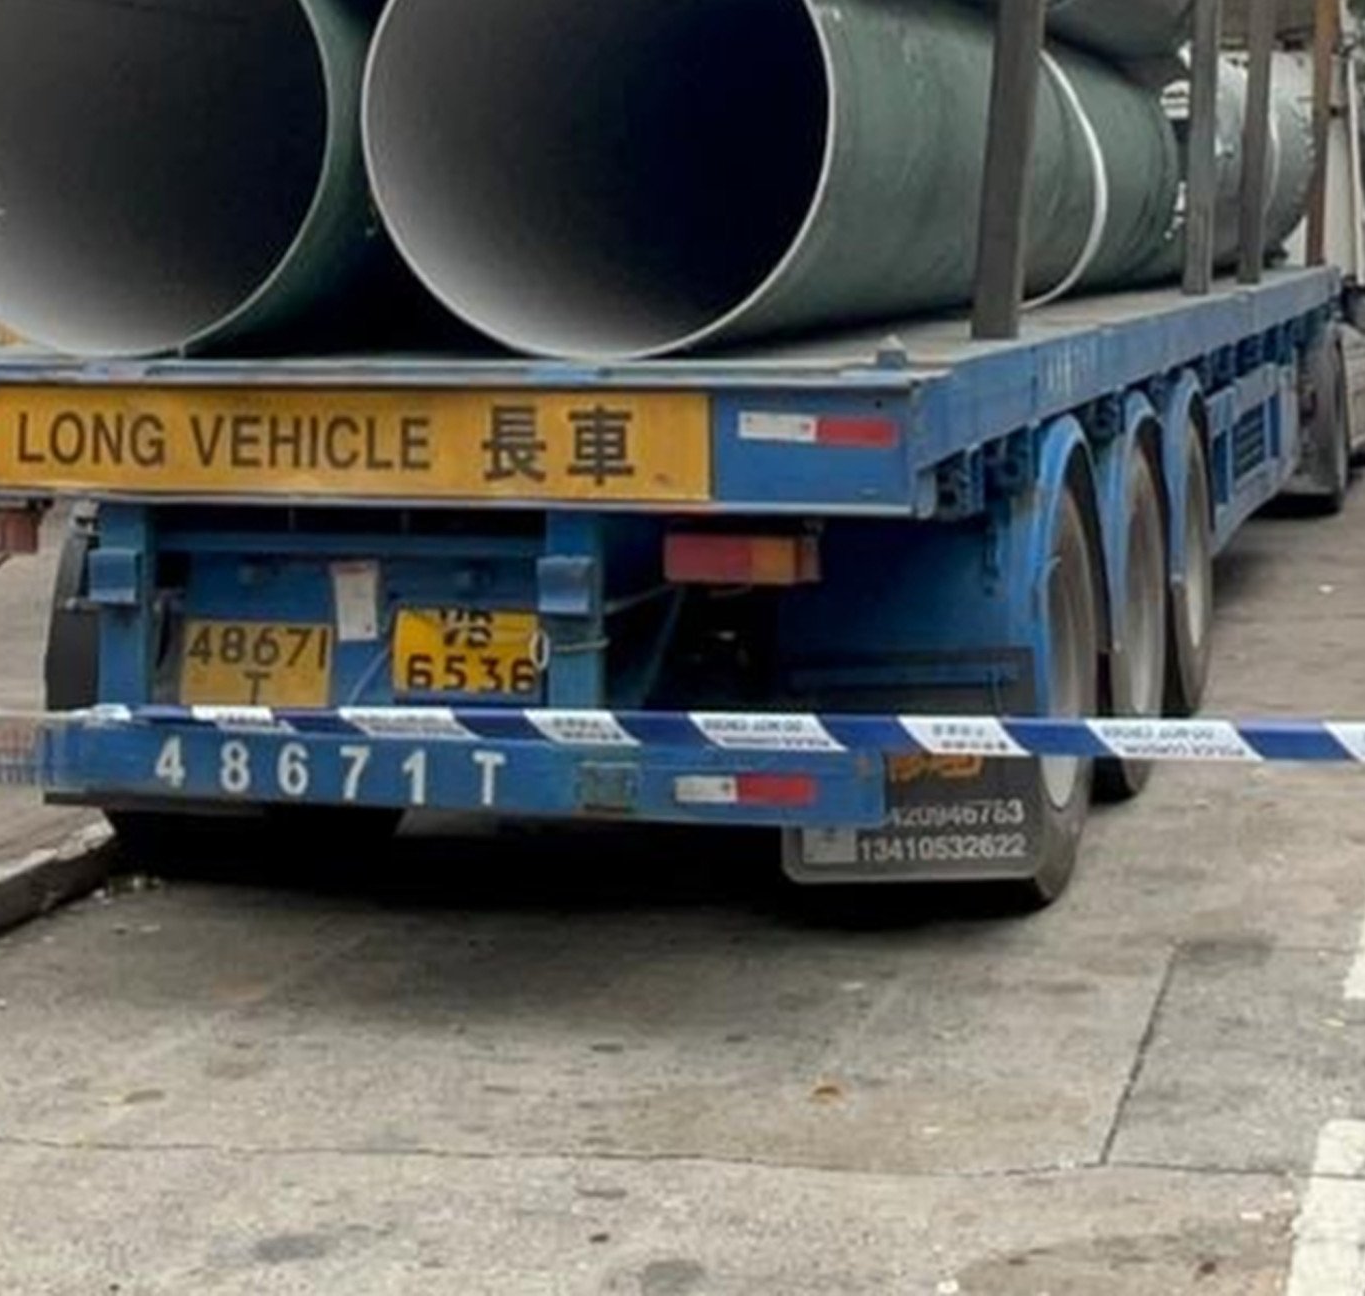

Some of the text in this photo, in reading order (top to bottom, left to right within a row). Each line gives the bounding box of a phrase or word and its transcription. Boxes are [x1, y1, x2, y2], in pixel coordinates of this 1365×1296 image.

[16, 405, 635, 487] LONG VEHICLE 長車
[187, 625, 328, 670] 48671
[243, 670, 272, 705] T
[406, 653, 537, 694] 6536
